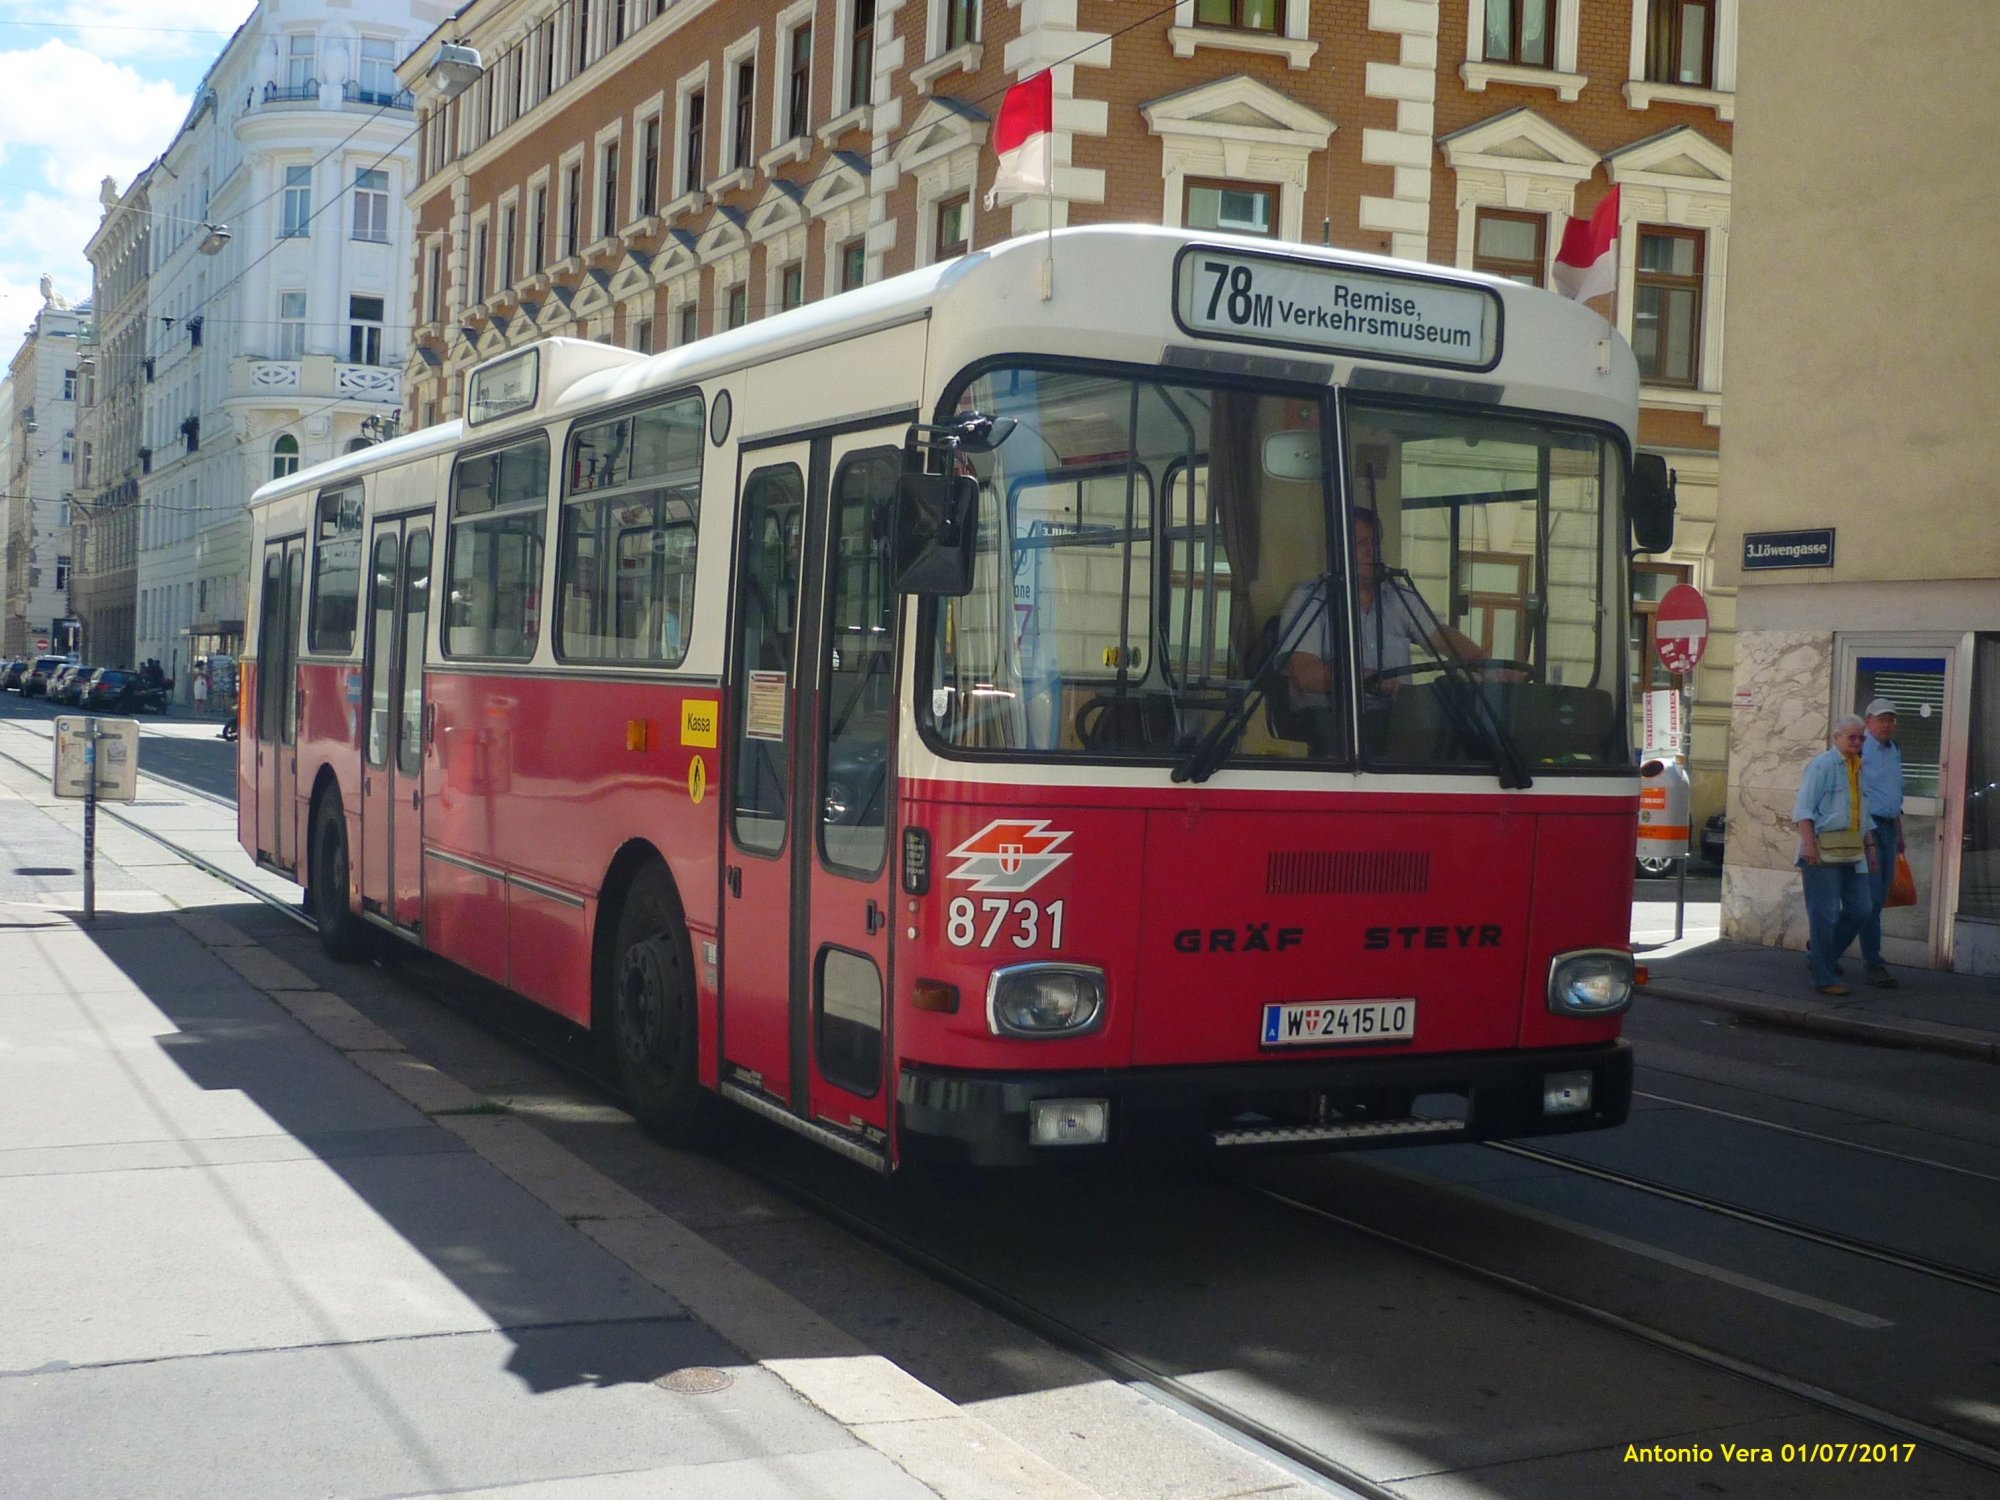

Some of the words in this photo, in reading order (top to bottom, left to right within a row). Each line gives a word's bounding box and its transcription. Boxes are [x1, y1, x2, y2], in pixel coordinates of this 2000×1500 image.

[1334, 285, 1422, 320] Remise,
[1278, 300, 1472, 347] Verkehrsmuseum
[687, 712, 711, 733] Kassa
[946, 896, 1064, 949] 8731
[1174, 923, 1305, 954] GRÄF
[1364, 925, 1504, 950] STEYR
[1268, 1028, 1276, 1037] A
